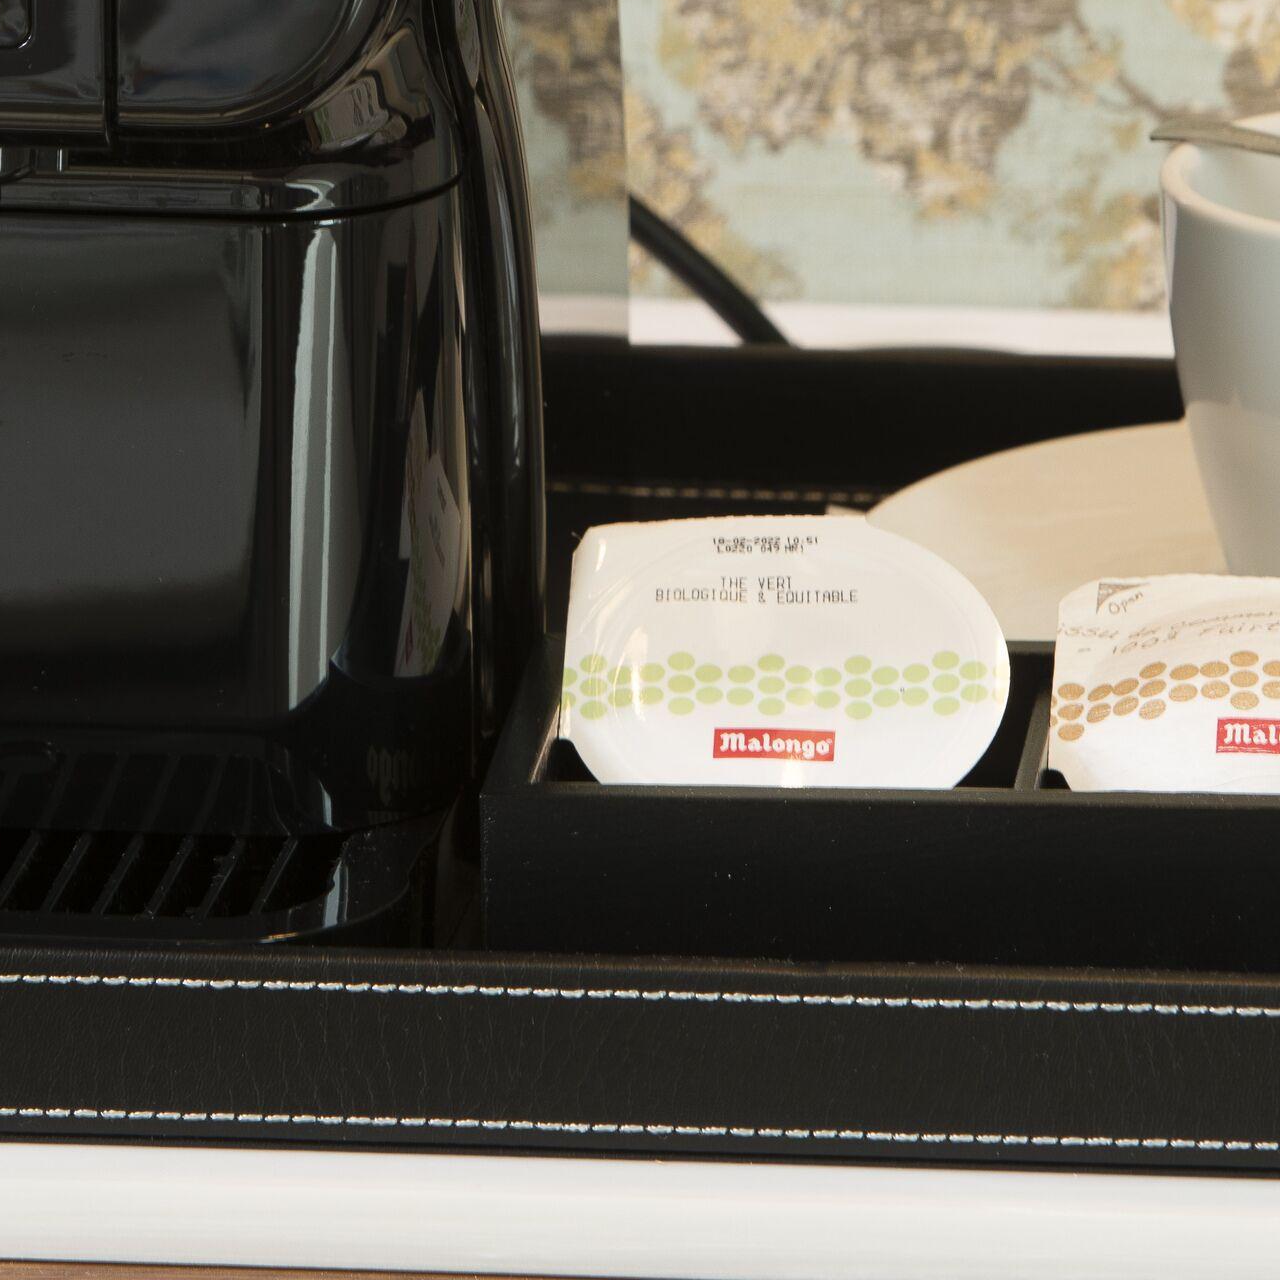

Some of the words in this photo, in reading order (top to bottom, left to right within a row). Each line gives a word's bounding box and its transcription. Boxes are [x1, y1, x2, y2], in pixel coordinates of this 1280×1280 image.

[720, 576, 748, 591] THE
[757, 576, 792, 590] VERT
[655, 587, 748, 603] BIOLOGIQUE
[757, 589, 767, 603] &
[776, 589, 859, 604] EQUITABLE
[1107, 591, 1144, 615] Open
[719, 732, 831, 760] Malongo
